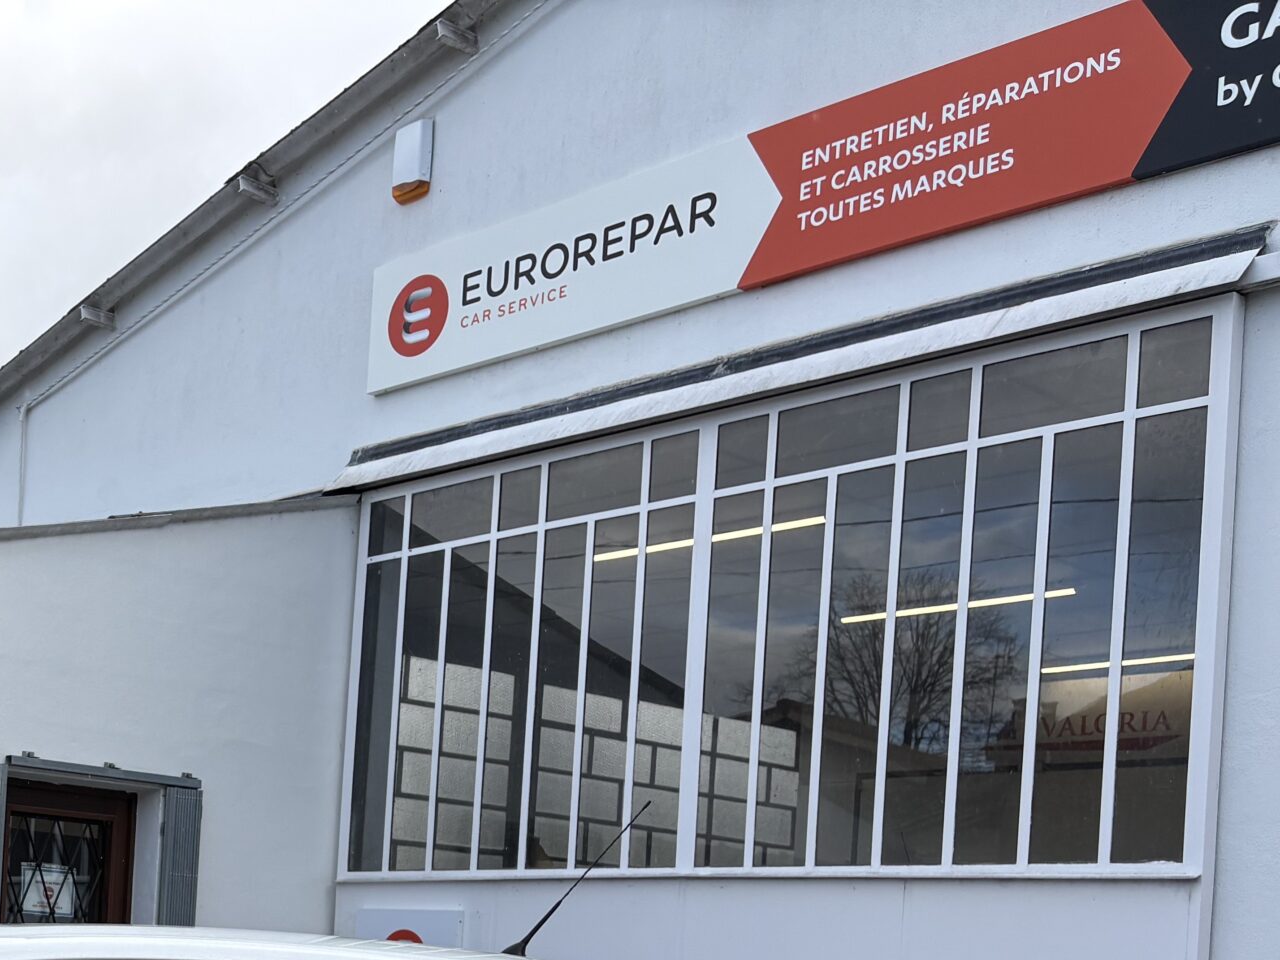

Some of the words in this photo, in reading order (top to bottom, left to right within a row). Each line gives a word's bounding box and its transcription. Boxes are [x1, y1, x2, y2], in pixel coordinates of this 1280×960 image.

[801, 112, 934, 170] ENTRETIEN,
[941, 48, 1121, 124] RÉPARATIONS
[1217, 74, 1263, 107] by
[797, 188, 885, 231] TOUTES
[890, 148, 1015, 204] MARQUES
[799, 176, 826, 201] ET
[830, 123, 990, 190] CARROSSERIE
[461, 192, 717, 307] EUROREPAR
[460, 308, 492, 328] CAR
[497, 284, 568, 317] SERVICE
